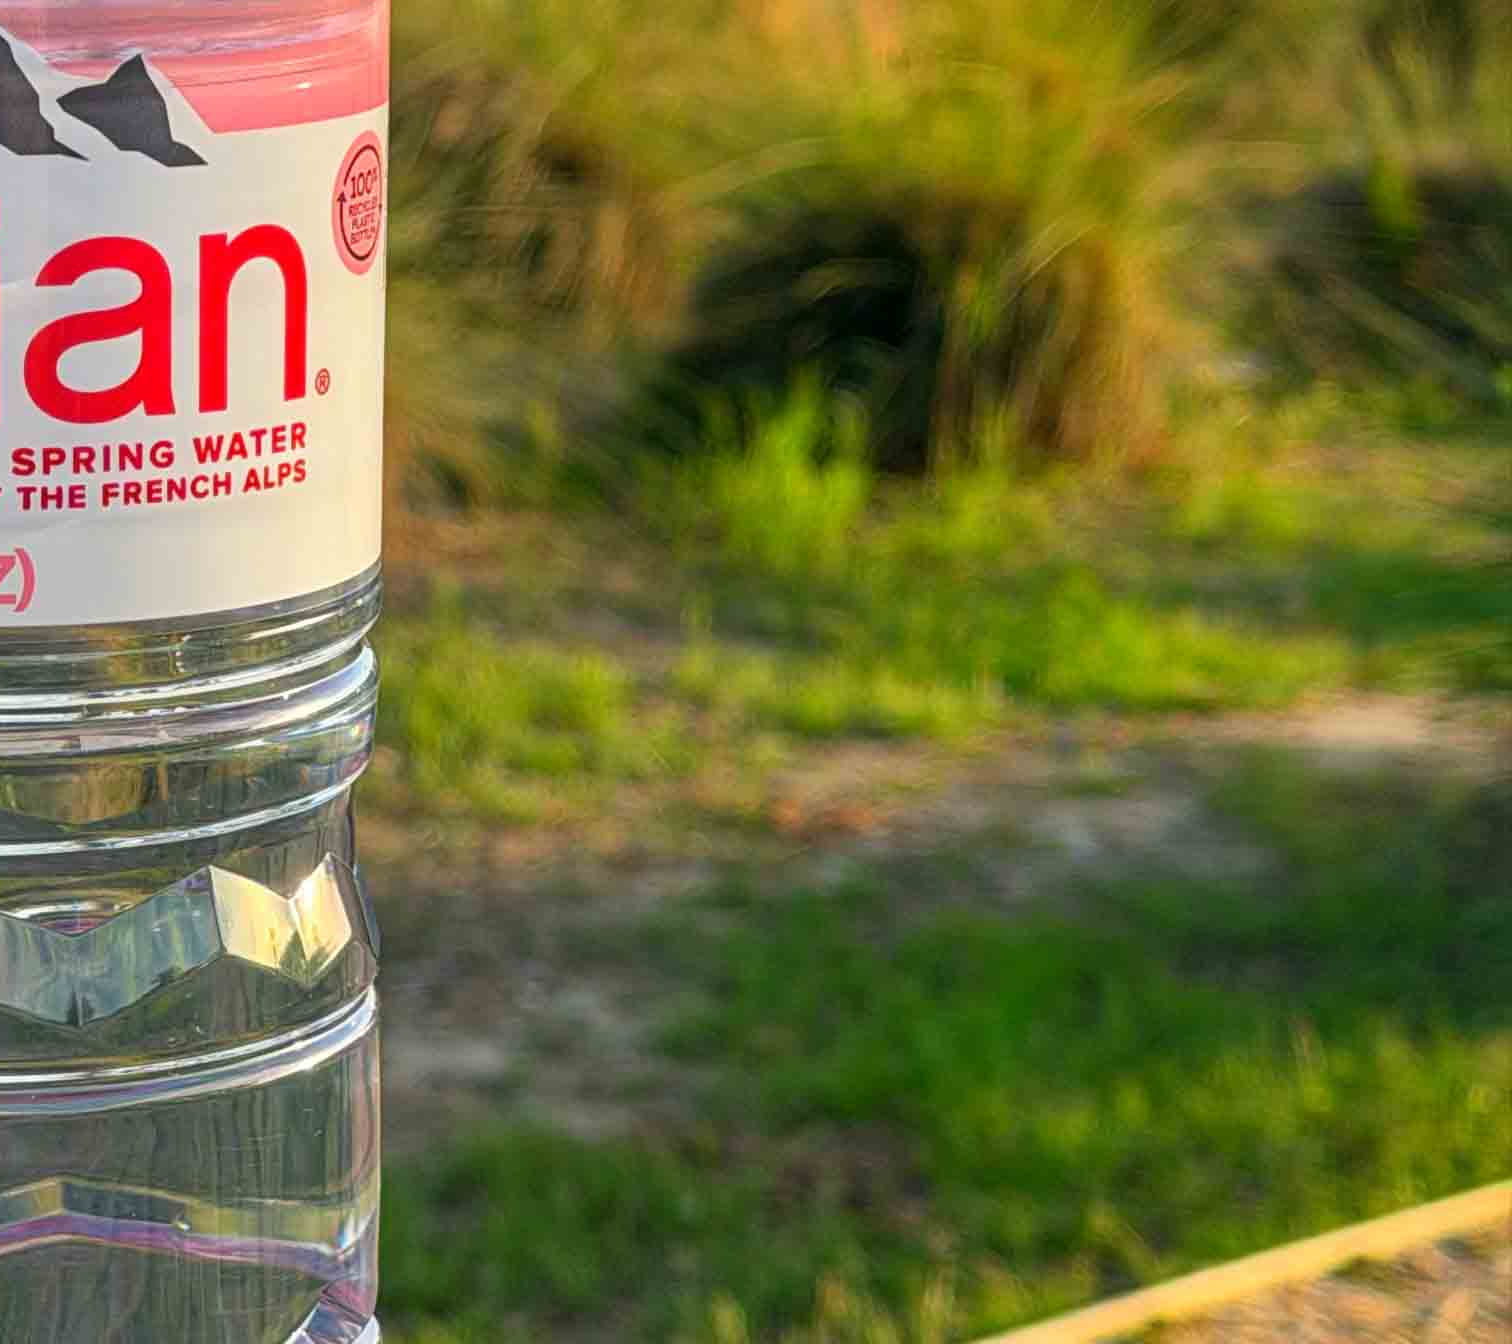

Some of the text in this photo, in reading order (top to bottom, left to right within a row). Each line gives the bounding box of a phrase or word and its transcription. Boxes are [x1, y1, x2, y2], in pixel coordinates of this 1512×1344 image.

[11, 438, 176, 477] SPRING
[192, 421, 307, 465] WATER
[16, 484, 88, 512] THE
[99, 471, 234, 508] FRENCH
[241, 458, 307, 494] ALPS
